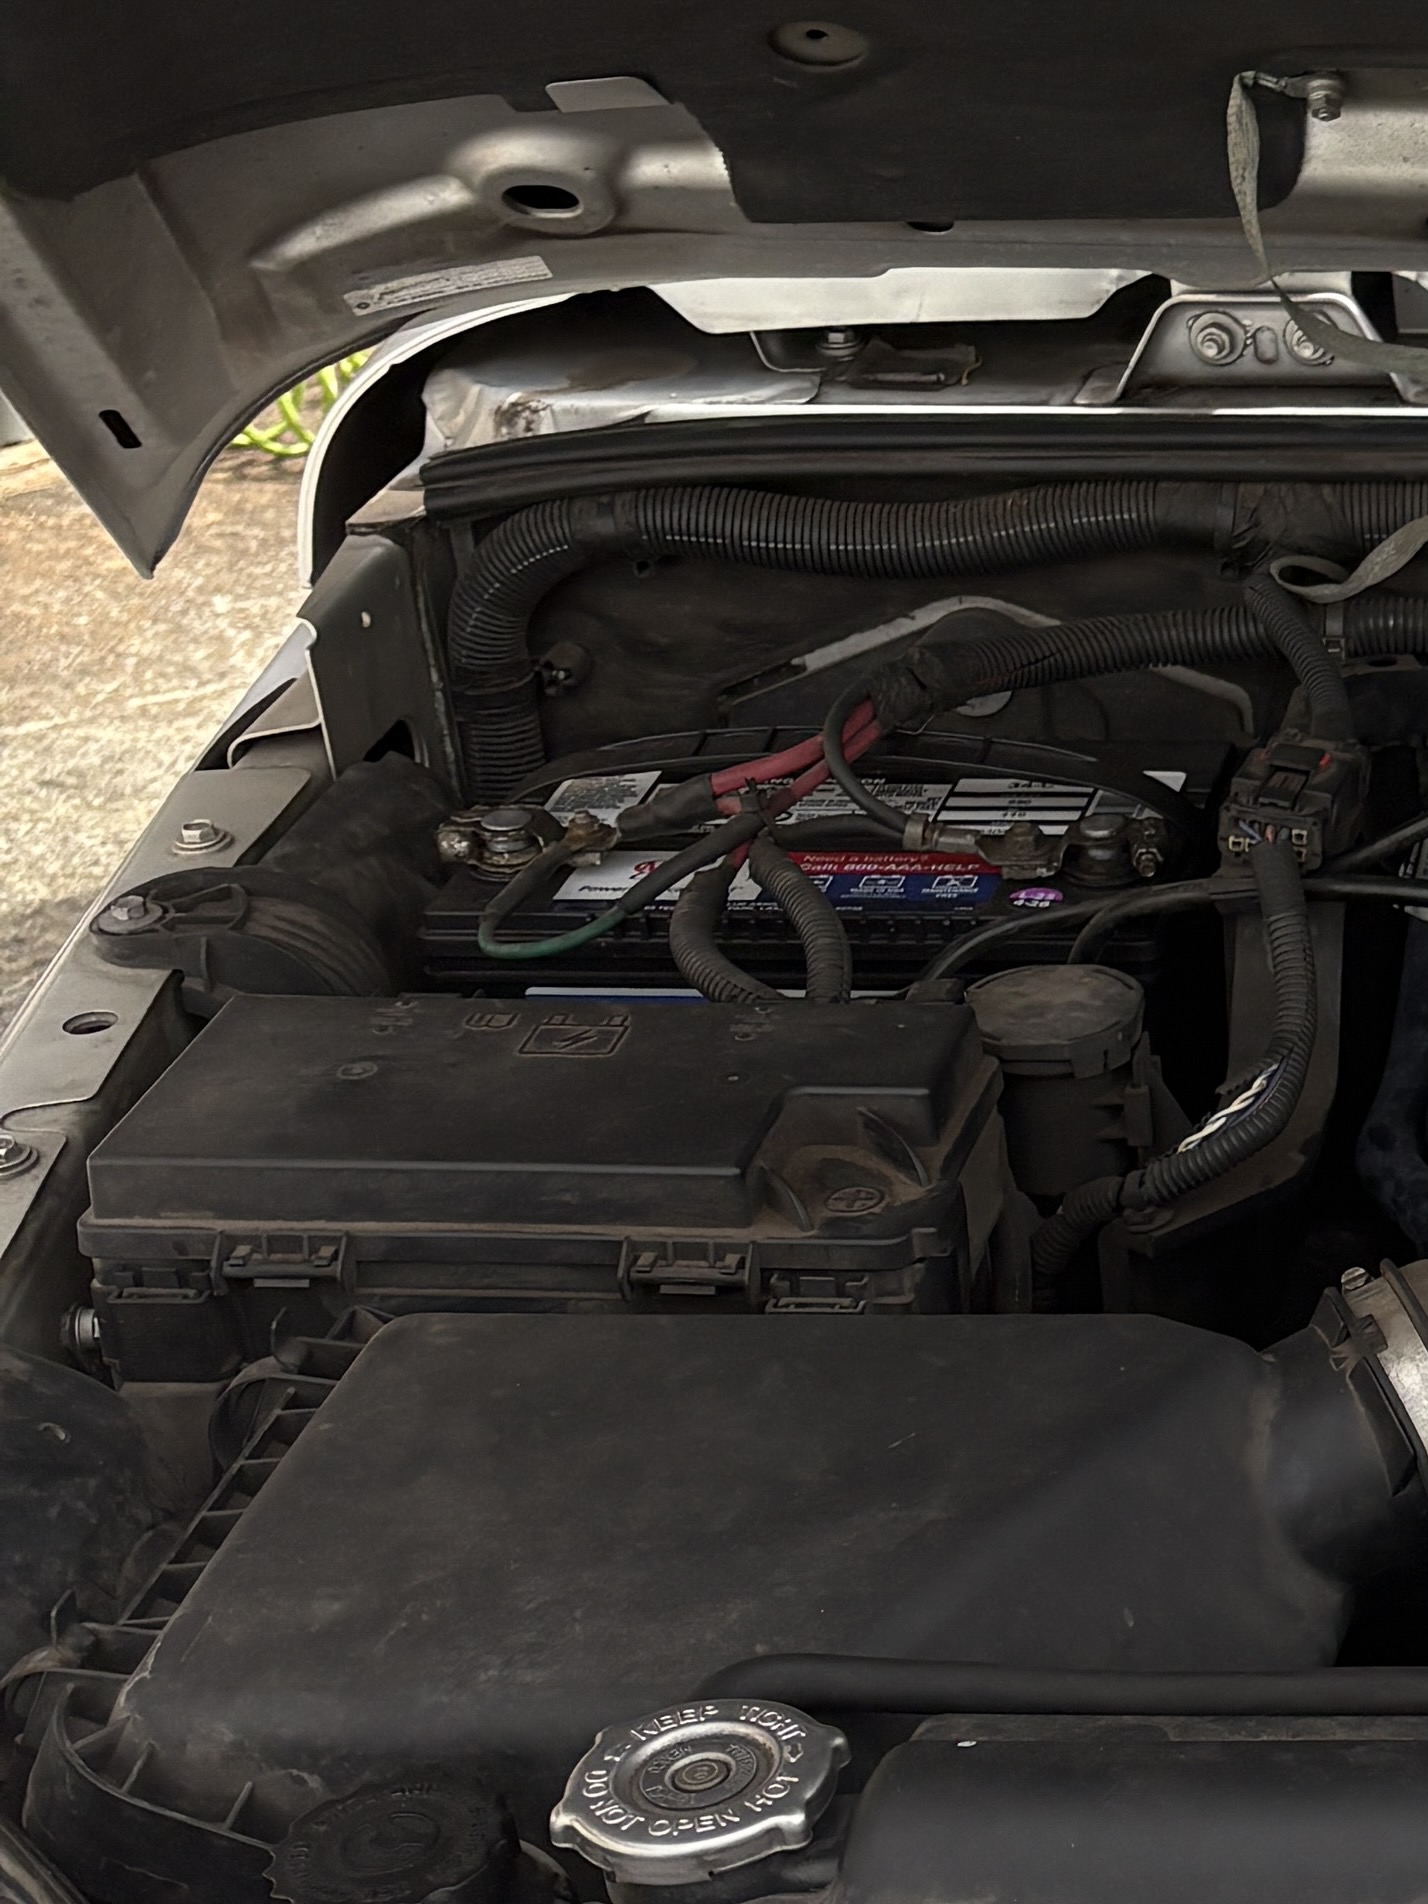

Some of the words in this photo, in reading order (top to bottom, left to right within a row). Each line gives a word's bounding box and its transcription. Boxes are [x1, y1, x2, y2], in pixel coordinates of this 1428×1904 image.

[803, 855, 846, 863] Need
[629, 1704, 719, 1742] KEEP
[739, 1703, 807, 1743] TIGHT
[581, 1769, 608, 1799] DO
[743, 1775, 801, 1813] HOT
[588, 1798, 646, 1832] NOT
[647, 1807, 742, 1838] OPEN
